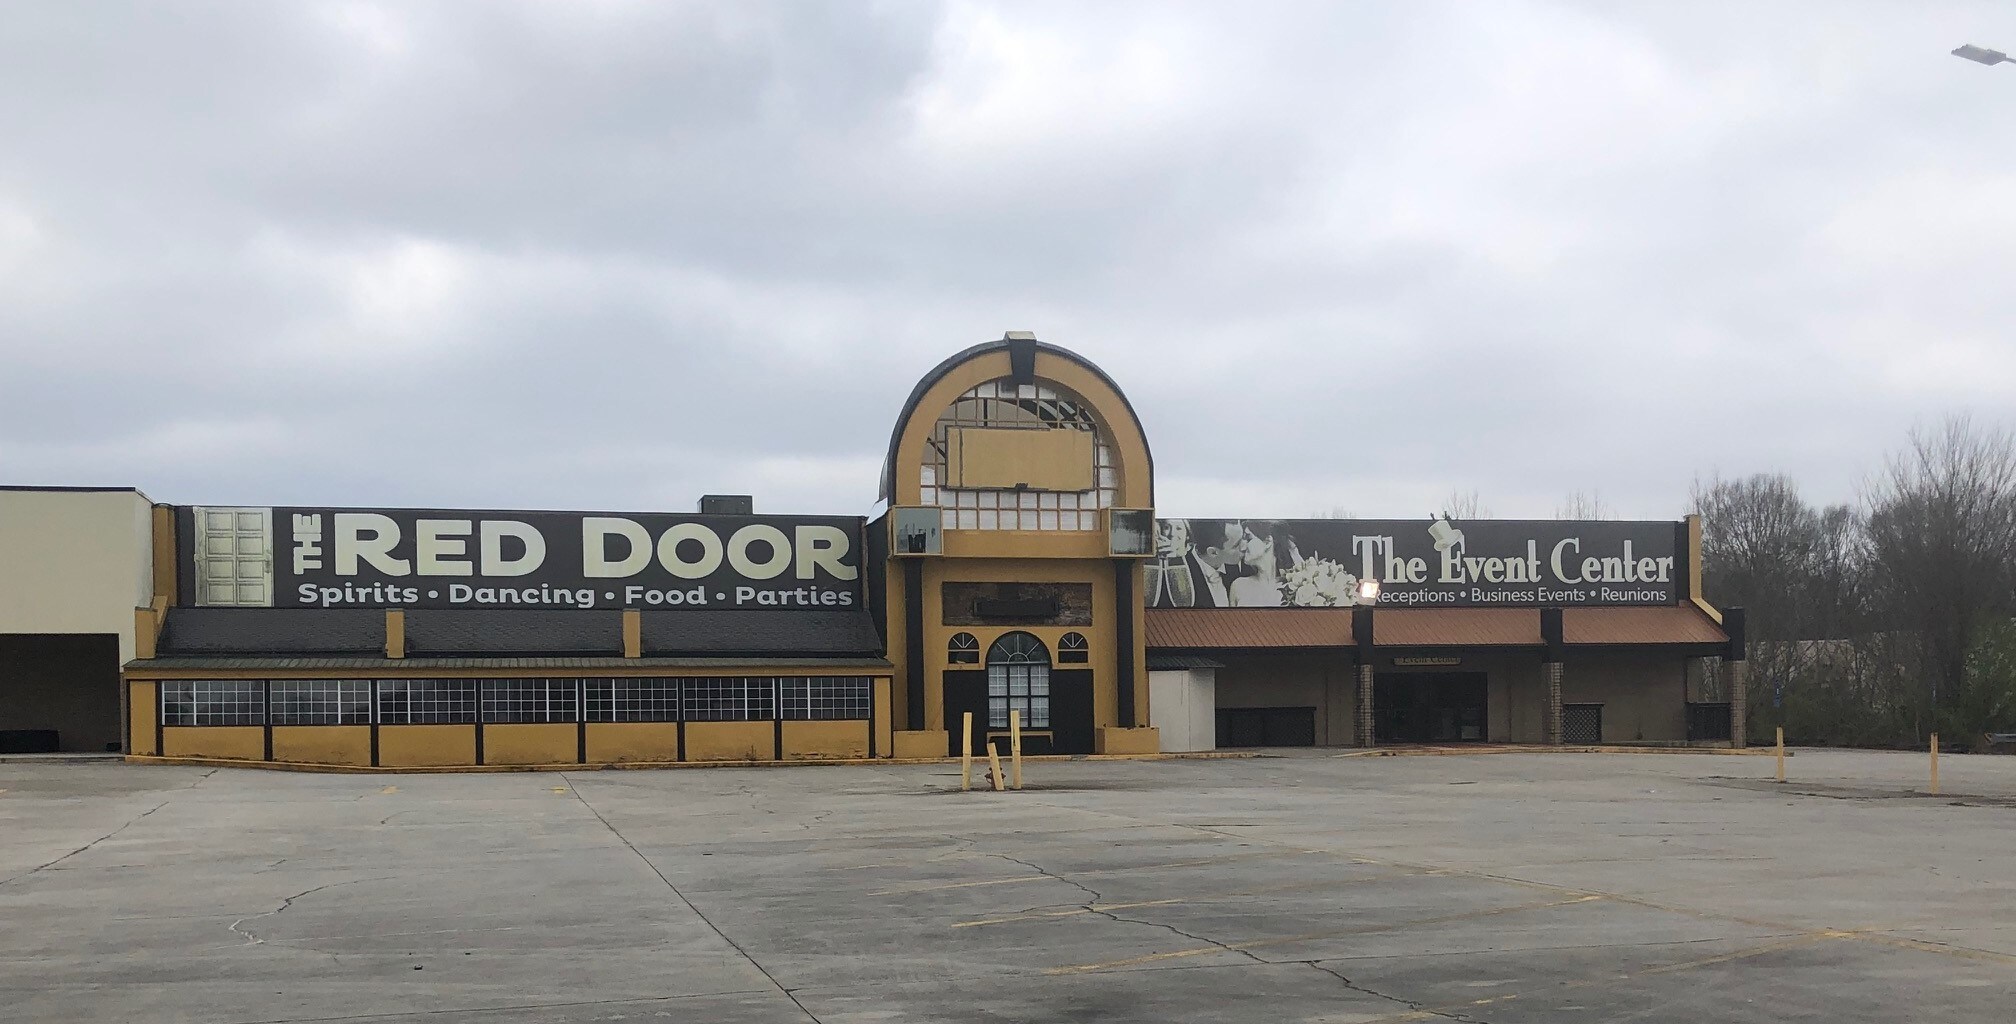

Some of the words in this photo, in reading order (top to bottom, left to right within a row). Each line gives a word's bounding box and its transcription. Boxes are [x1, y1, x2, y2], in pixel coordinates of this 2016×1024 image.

[293, 513, 322, 575] THE
[335, 512, 547, 577] RED
[582, 516, 858, 580] DOOR
[1352, 535, 1427, 584] The
[1437, 533, 1541, 584] Event
[1551, 537, 1673, 584] Center
[298, 582, 418, 608] Spirits
[449, 583, 594, 609] Dancing
[625, 585, 708, 605] Food
[735, 585, 852, 606] Parties
[1471, 588, 1535, 602] Business
[1538, 587, 1586, 602] Events
[1601, 587, 1667, 601] Reunions
